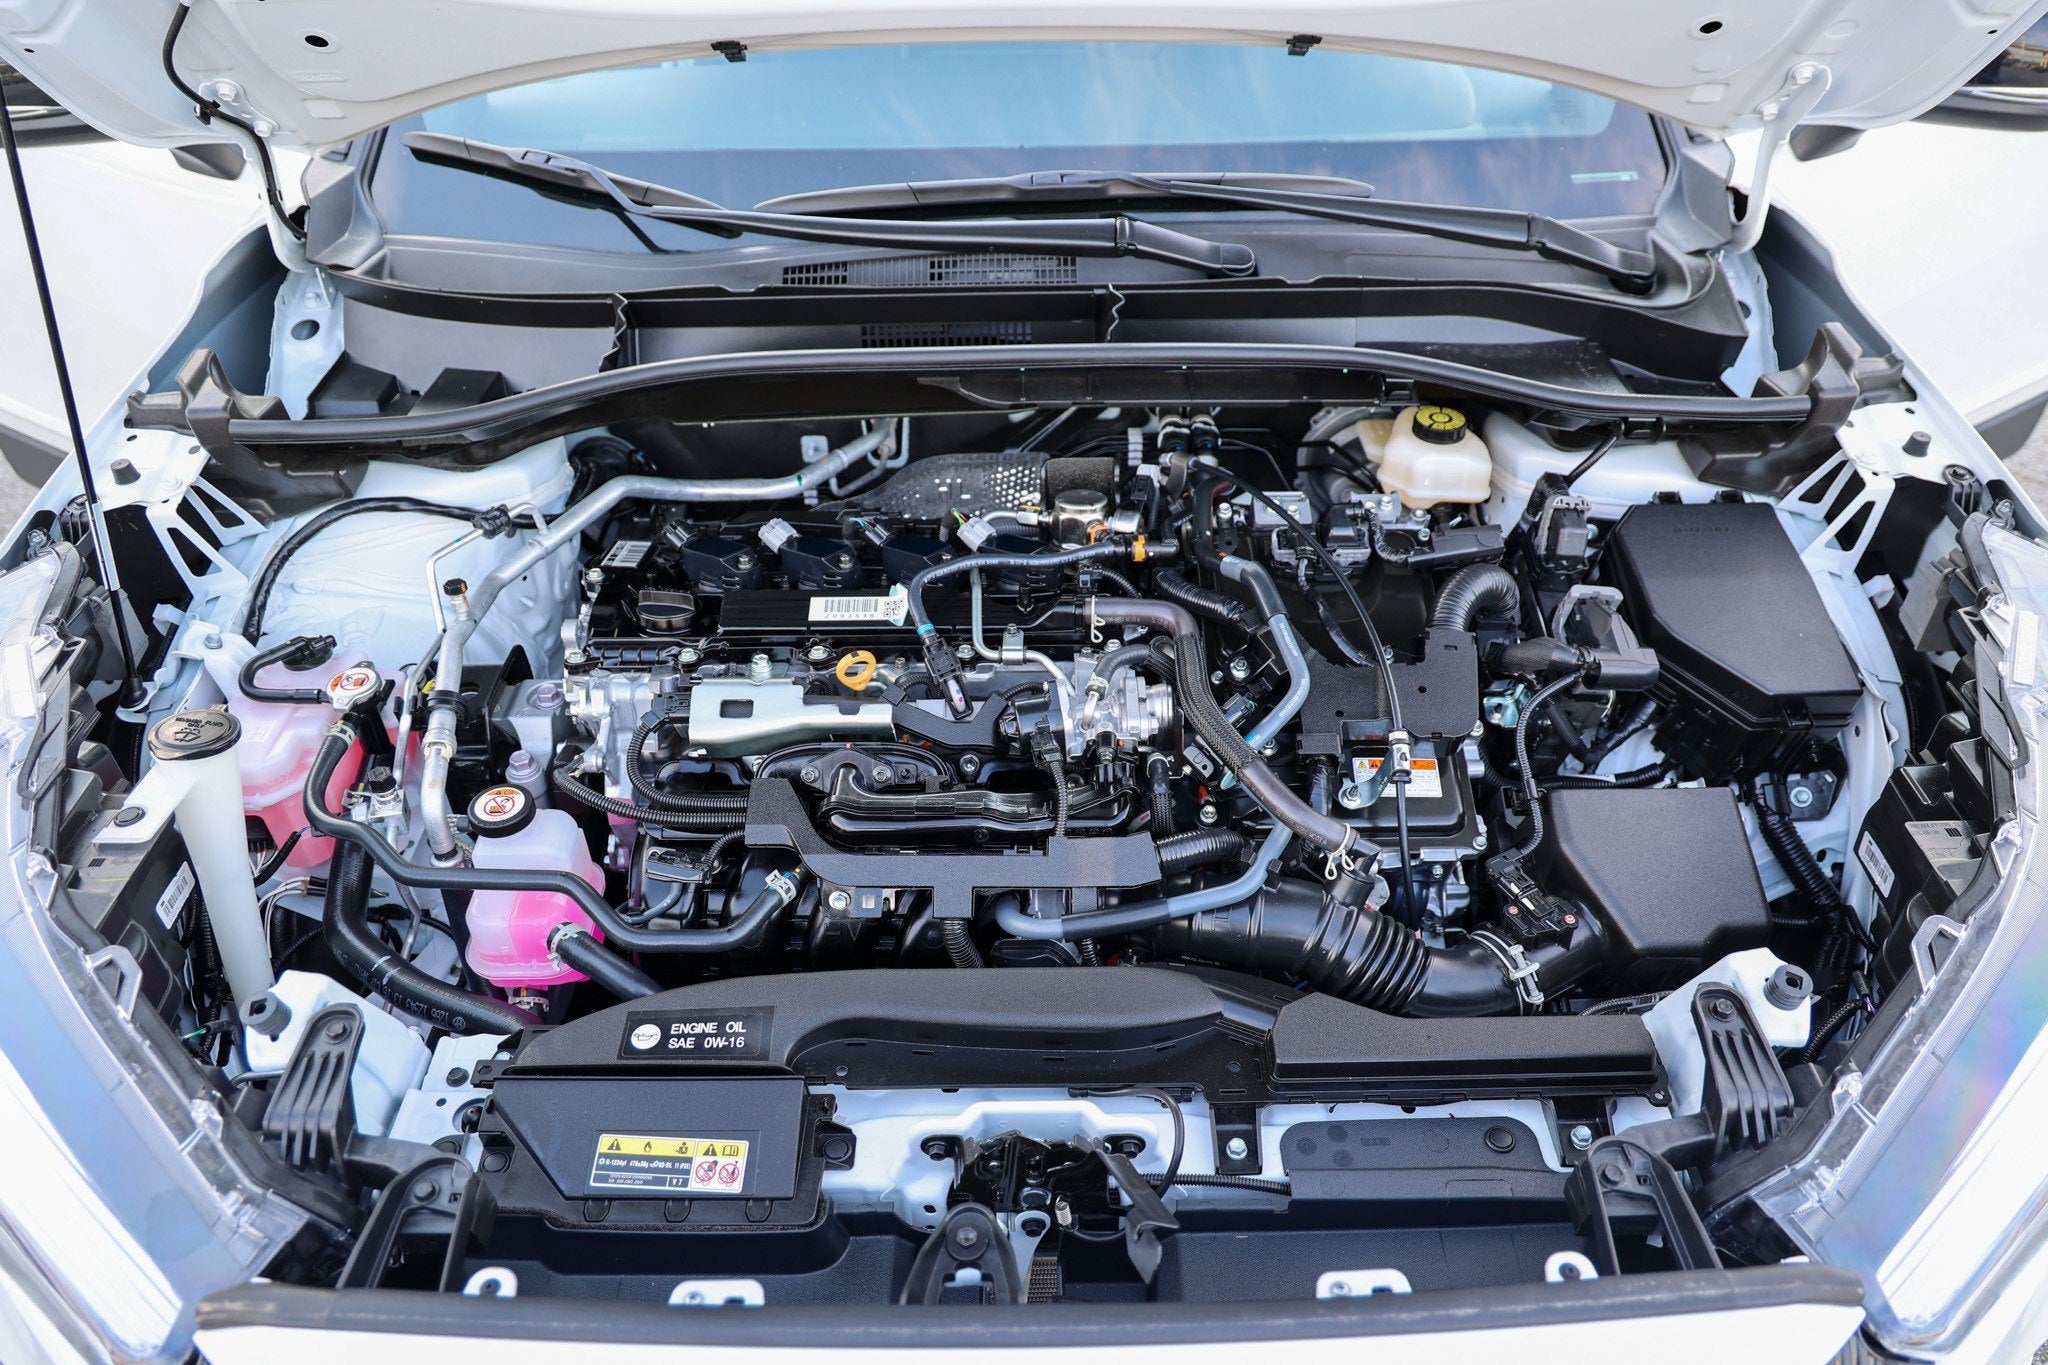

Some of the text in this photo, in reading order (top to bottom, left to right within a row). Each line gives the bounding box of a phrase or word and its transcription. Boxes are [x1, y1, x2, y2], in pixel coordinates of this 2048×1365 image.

[670, 1021, 747, 1035] ENGINE OIL
[668, 1036, 745, 1049] SAE 0W-16
